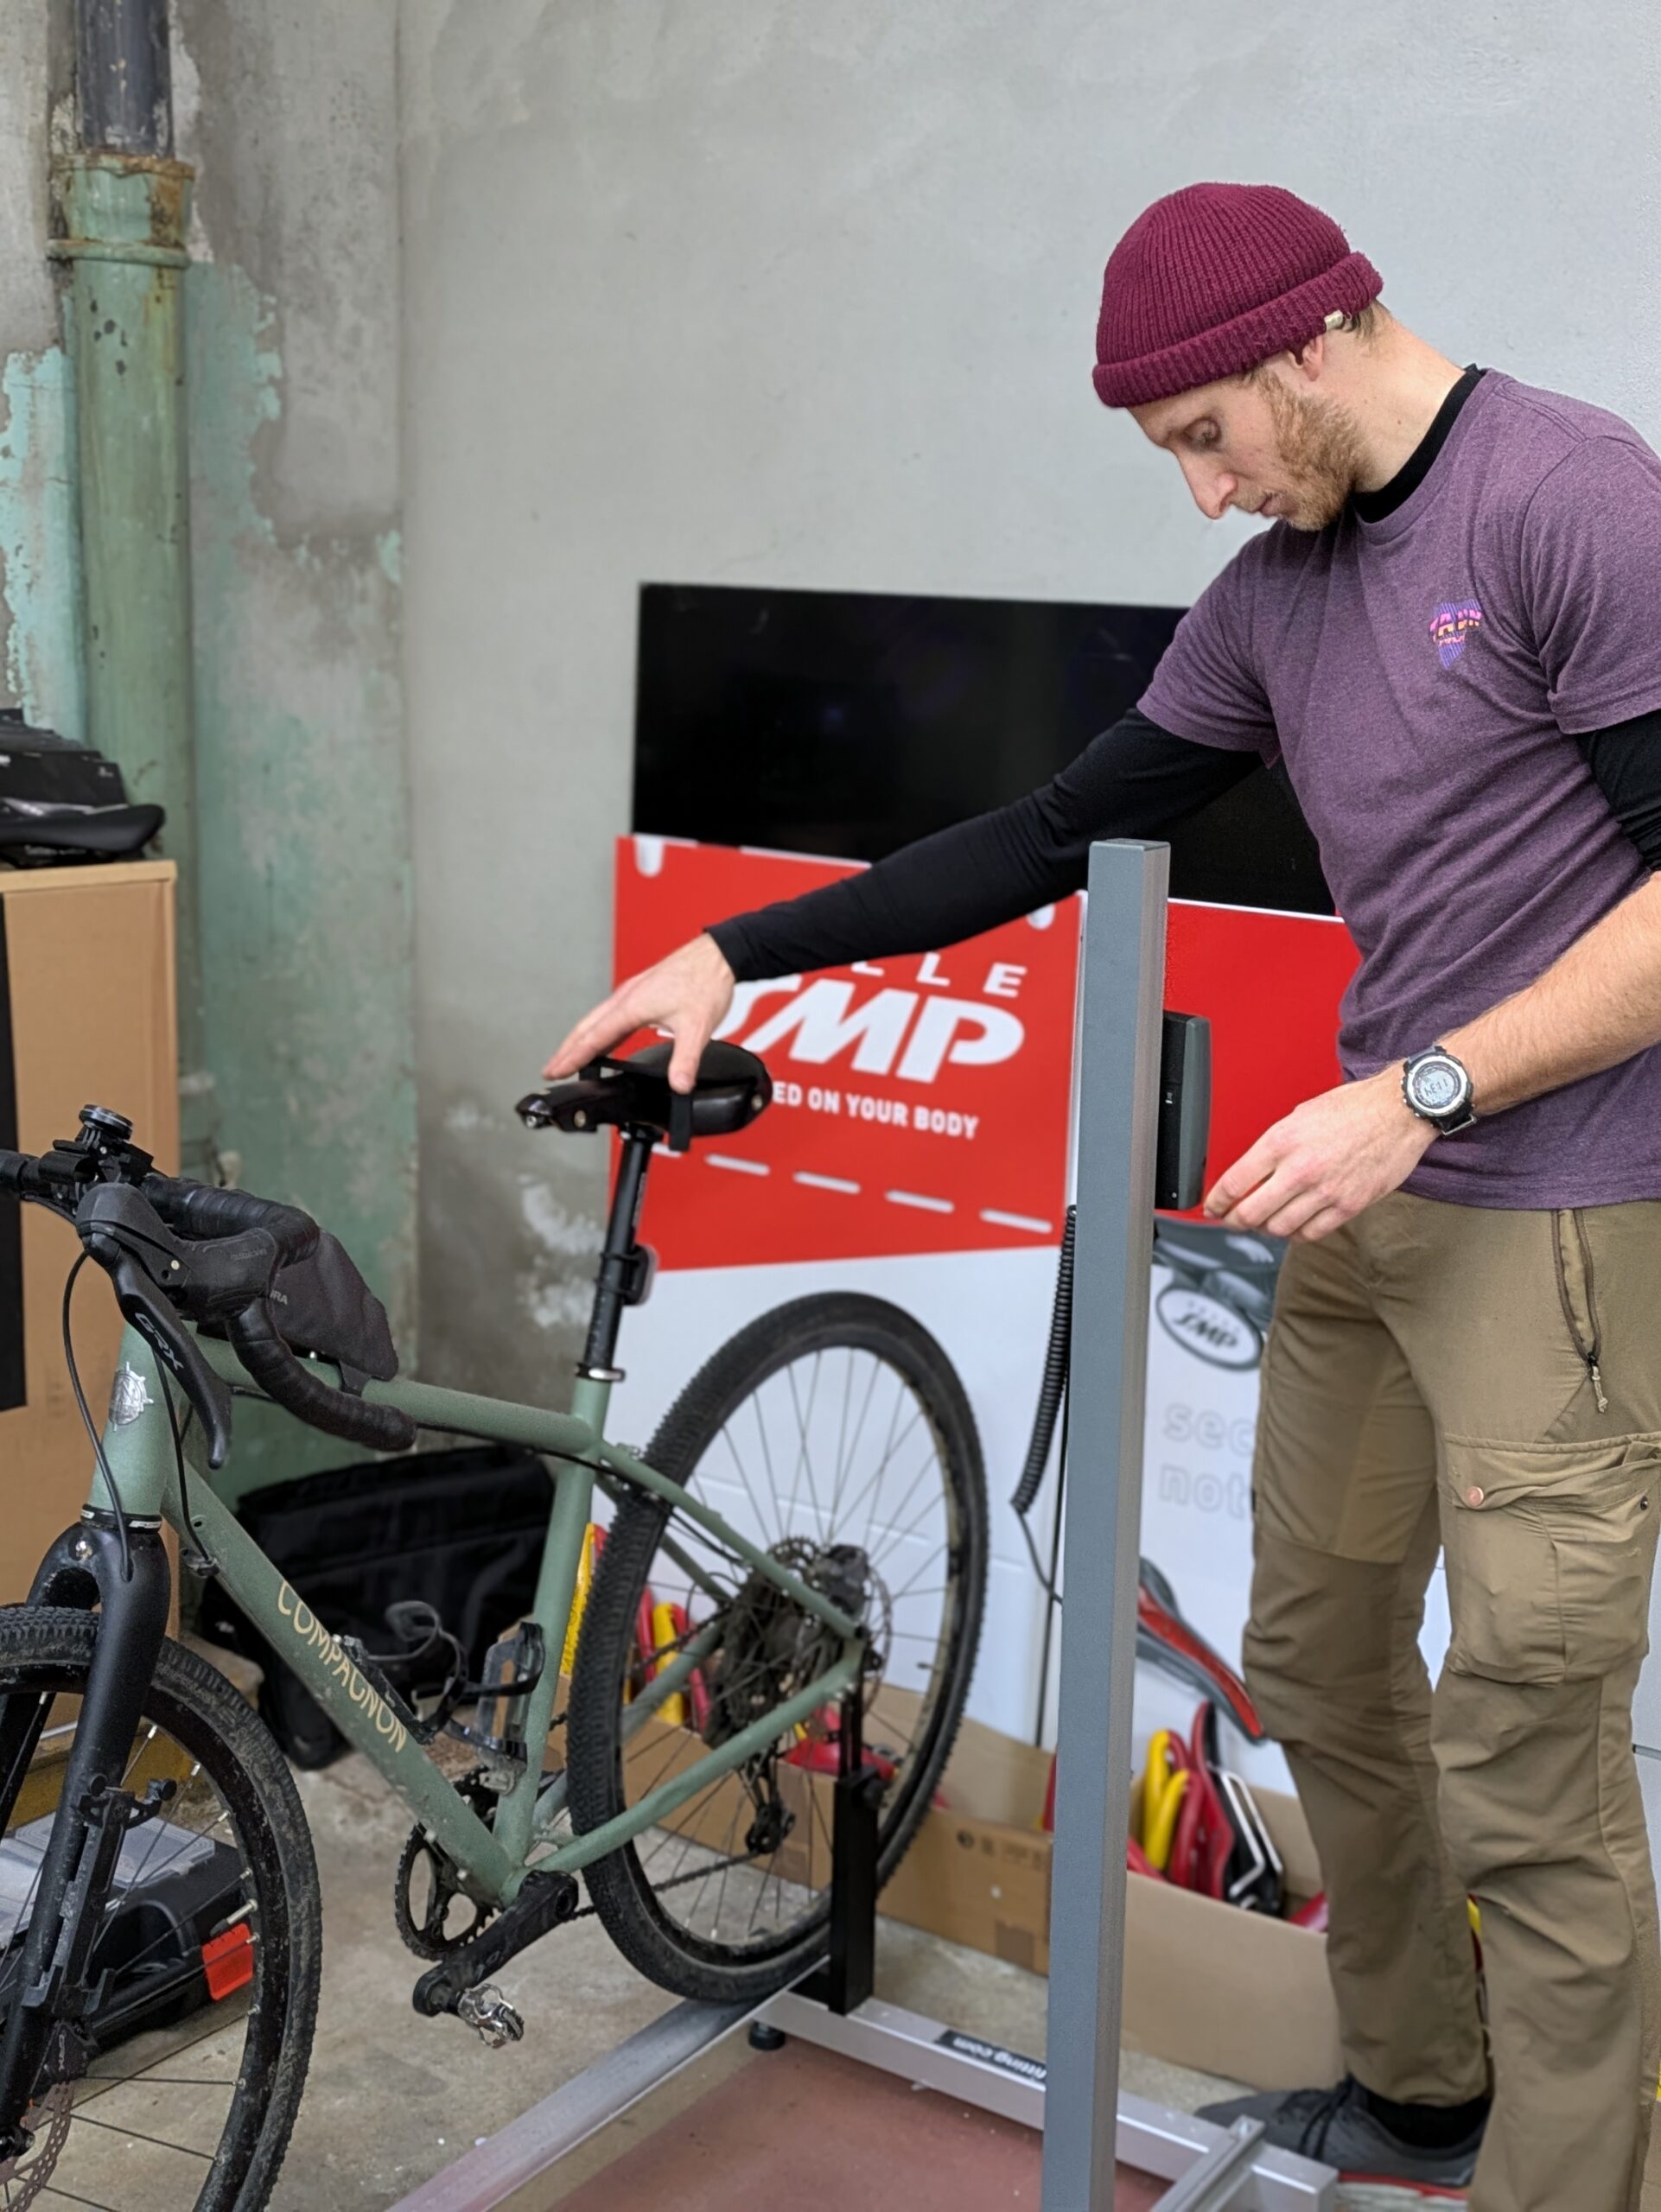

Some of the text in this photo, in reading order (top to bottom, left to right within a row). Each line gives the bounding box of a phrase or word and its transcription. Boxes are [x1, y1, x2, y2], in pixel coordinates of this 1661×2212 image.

[807, 1086, 841, 1114] ON
[846, 1093, 909, 1127] YOUR
[913, 1105, 980, 1140] BODY
[134, 1312, 185, 1371] GRX
[1158, 1463, 1249, 1521] not
[277, 1580, 407, 1753] COMPAGNON
